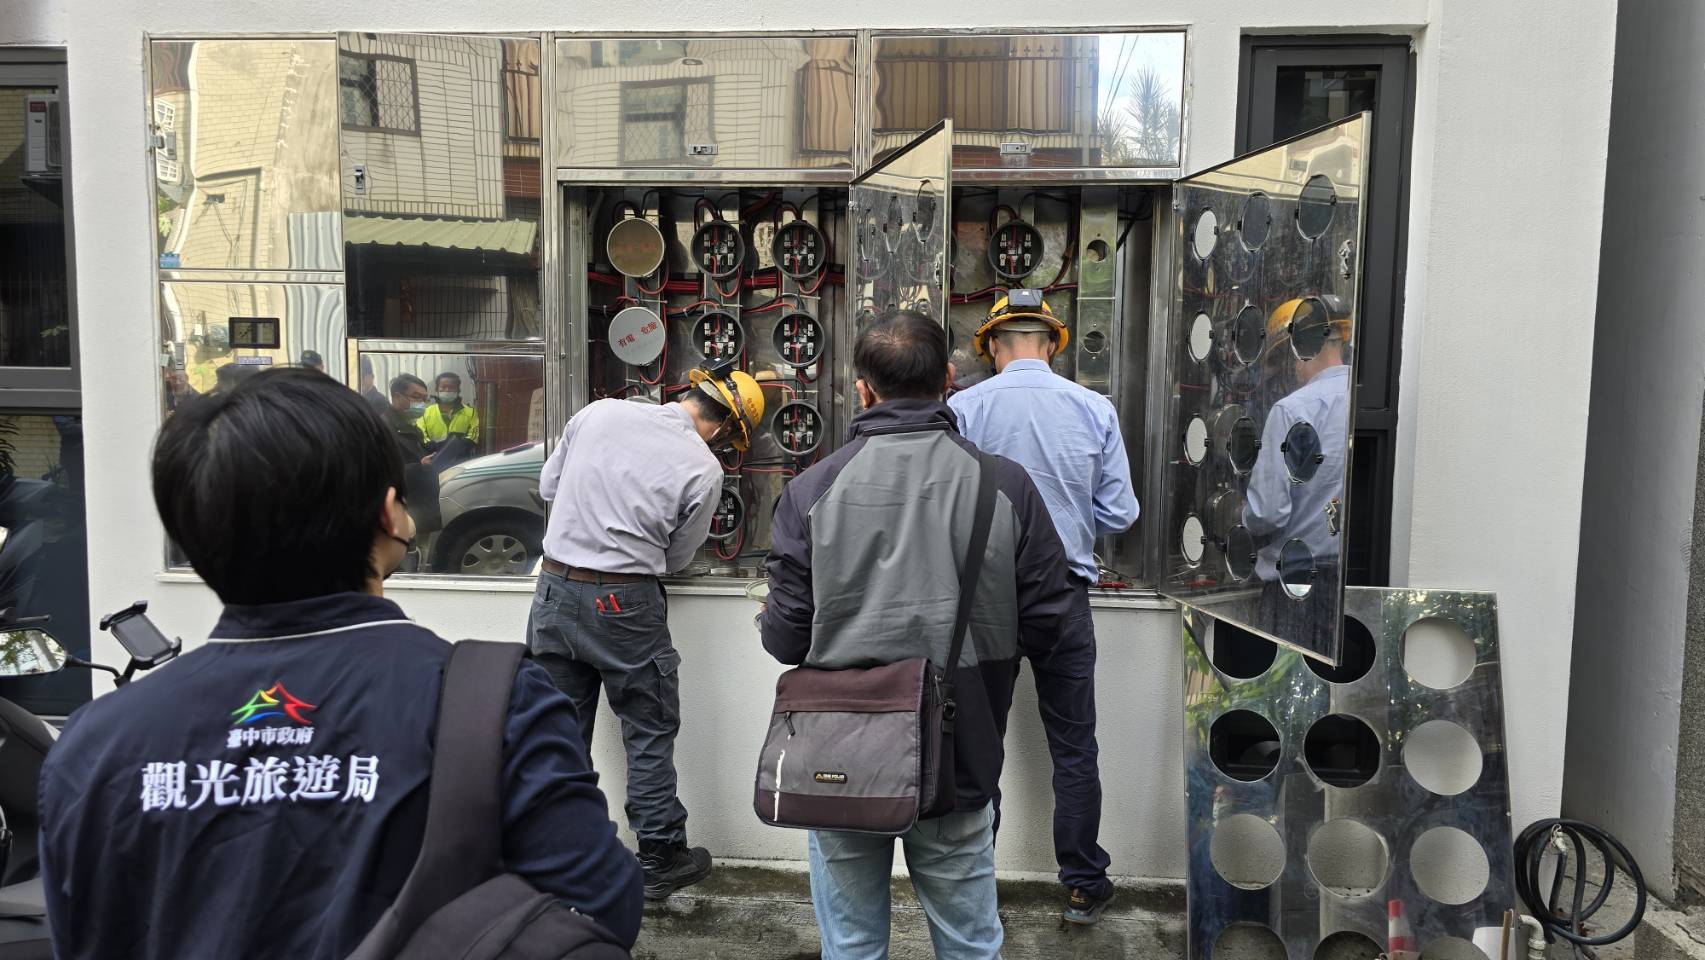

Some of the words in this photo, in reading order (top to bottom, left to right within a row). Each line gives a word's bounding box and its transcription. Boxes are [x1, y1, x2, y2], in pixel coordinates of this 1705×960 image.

[617, 333, 636, 348] 有電
[226, 726, 315, 748] 臺中市政府
[140, 754, 380, 812] 觀光旅遊局
